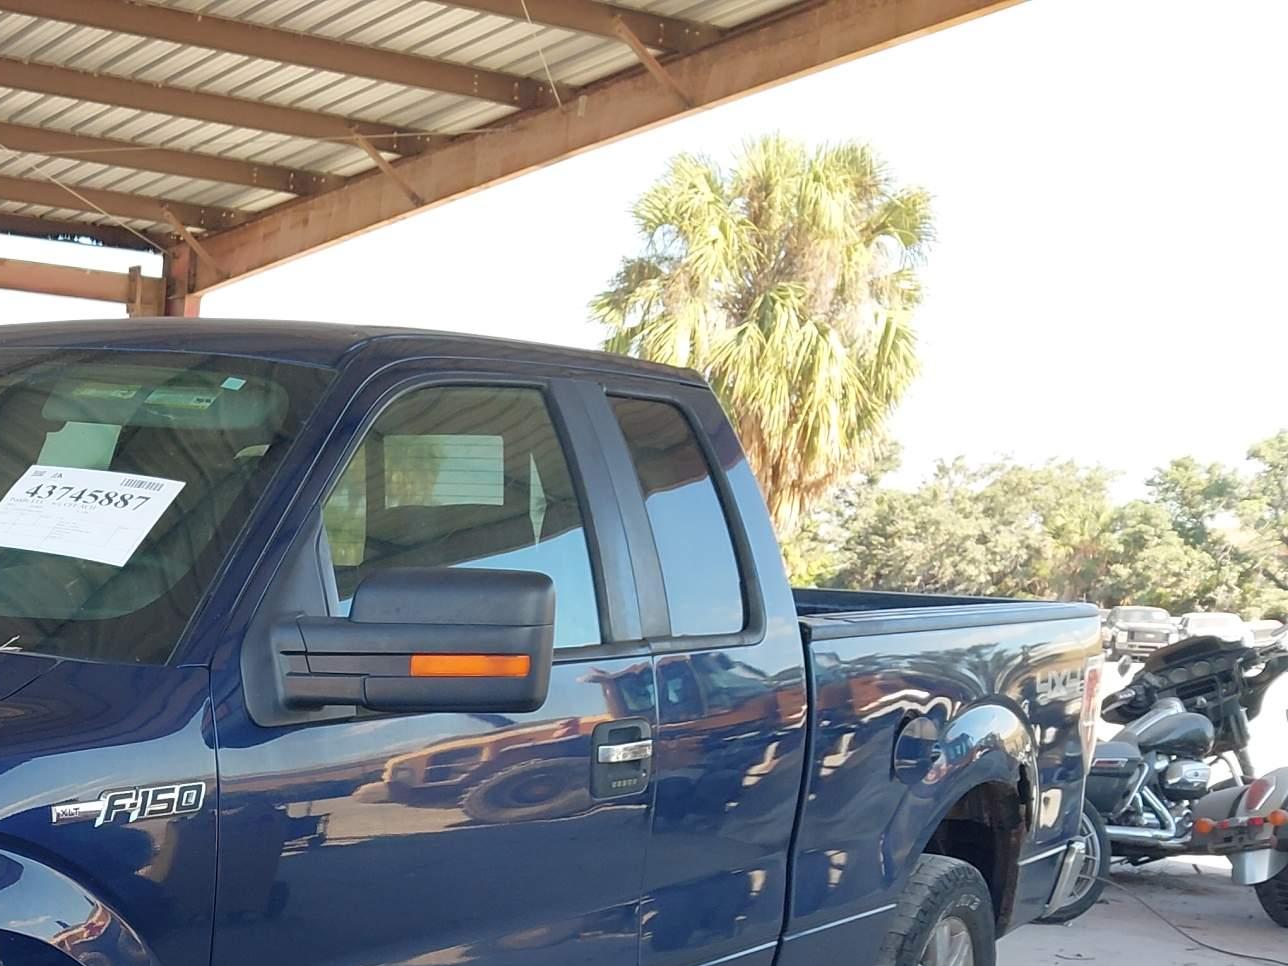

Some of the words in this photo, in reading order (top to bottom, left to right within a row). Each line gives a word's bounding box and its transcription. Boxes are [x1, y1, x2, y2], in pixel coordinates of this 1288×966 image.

[25, 483, 152, 511] 43745887
[60, 807, 80, 818] XLT
[94, 781, 206, 828] F-150
